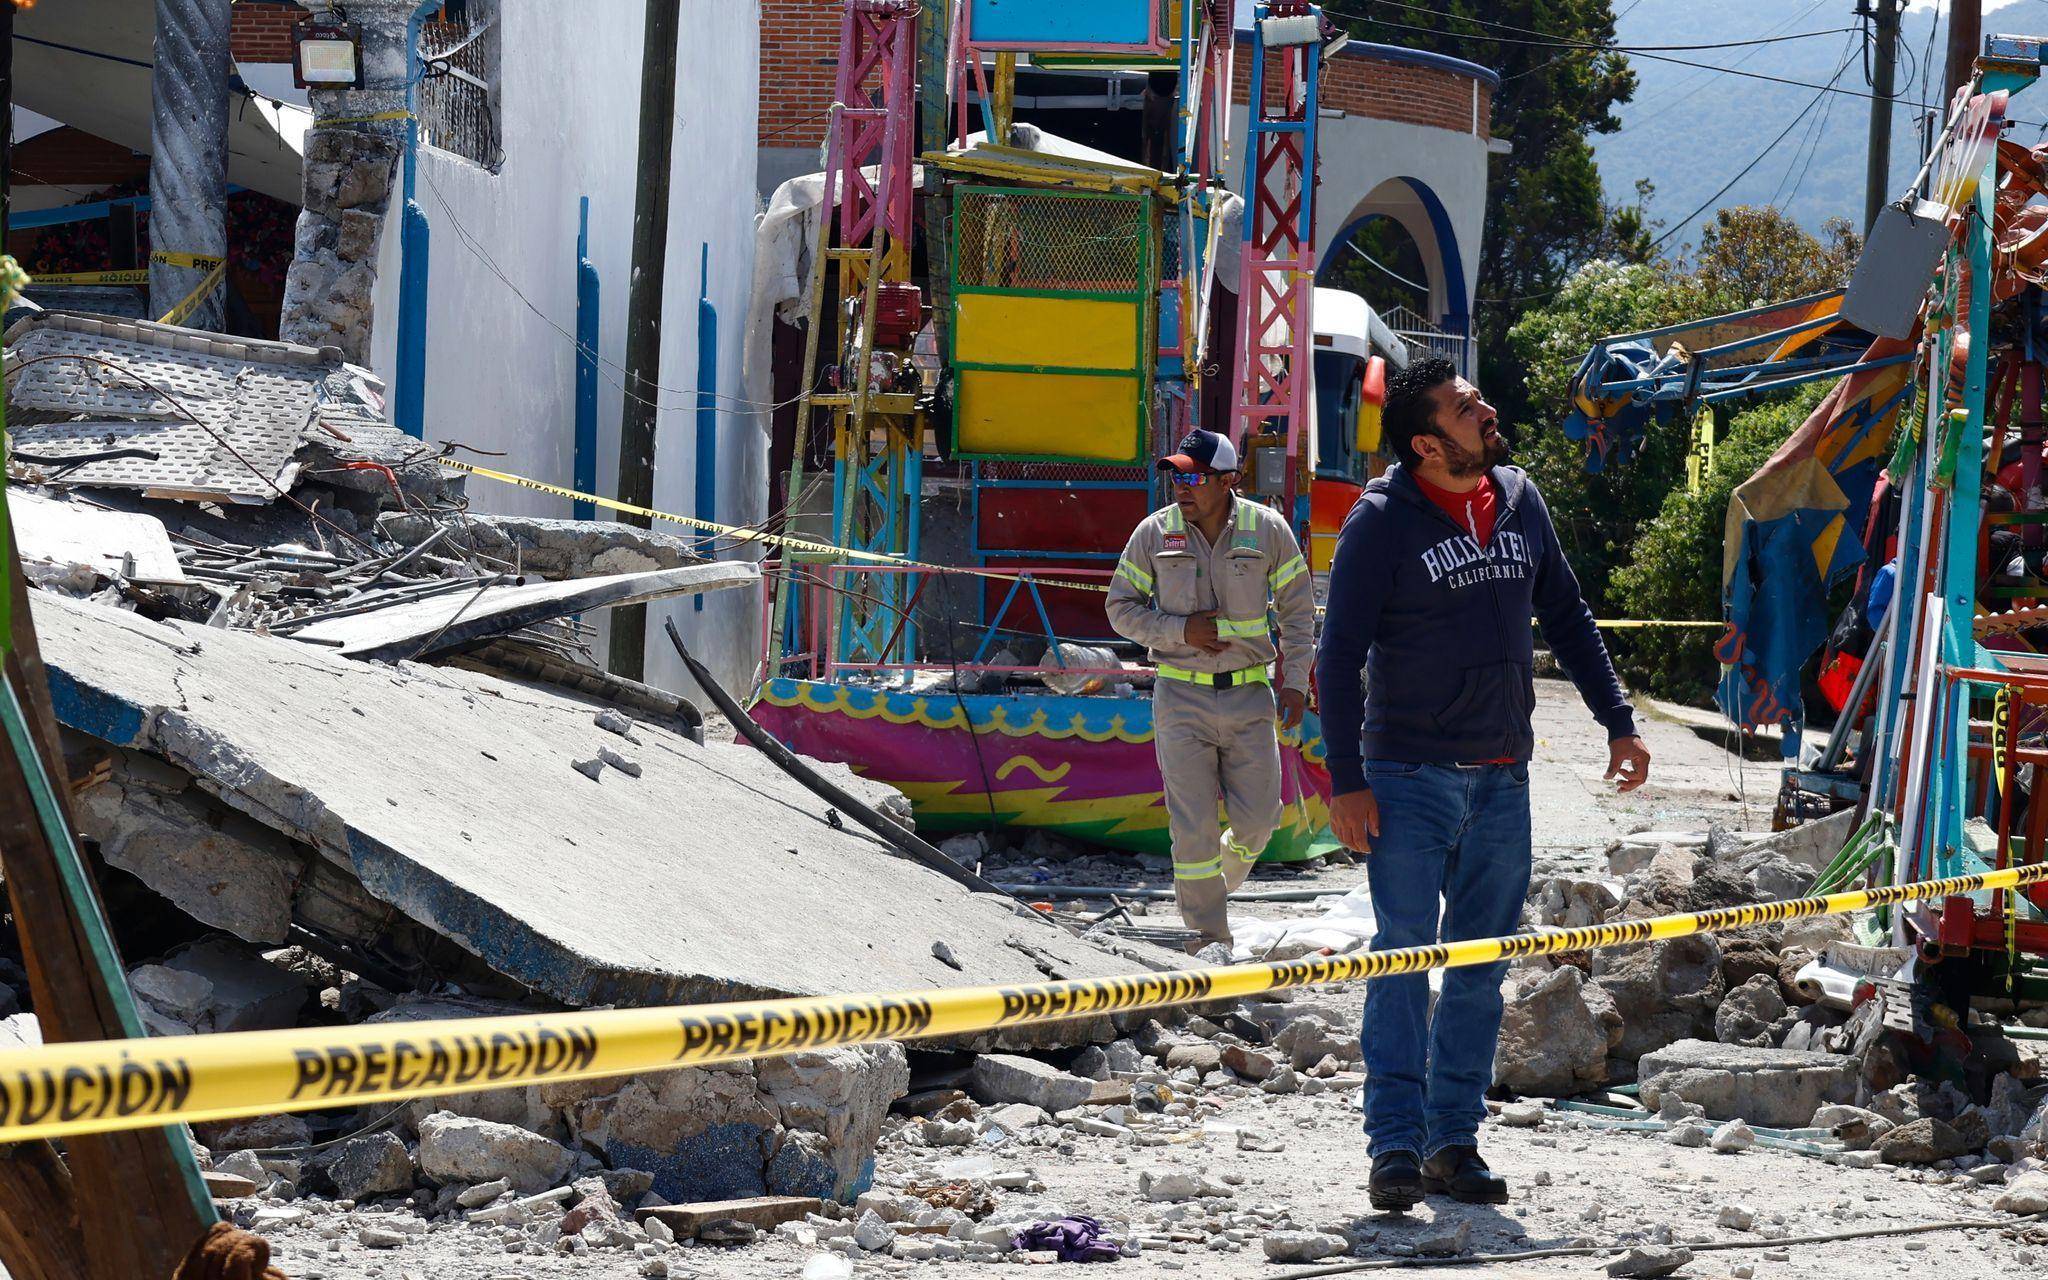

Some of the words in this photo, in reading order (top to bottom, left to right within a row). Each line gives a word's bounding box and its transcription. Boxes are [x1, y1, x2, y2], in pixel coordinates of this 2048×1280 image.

[1448, 564, 1525, 589] CALIFORNIA
[0, 1050, 191, 1126] UCIÓN
[289, 1021, 599, 1099] PRECAUCIÓN
